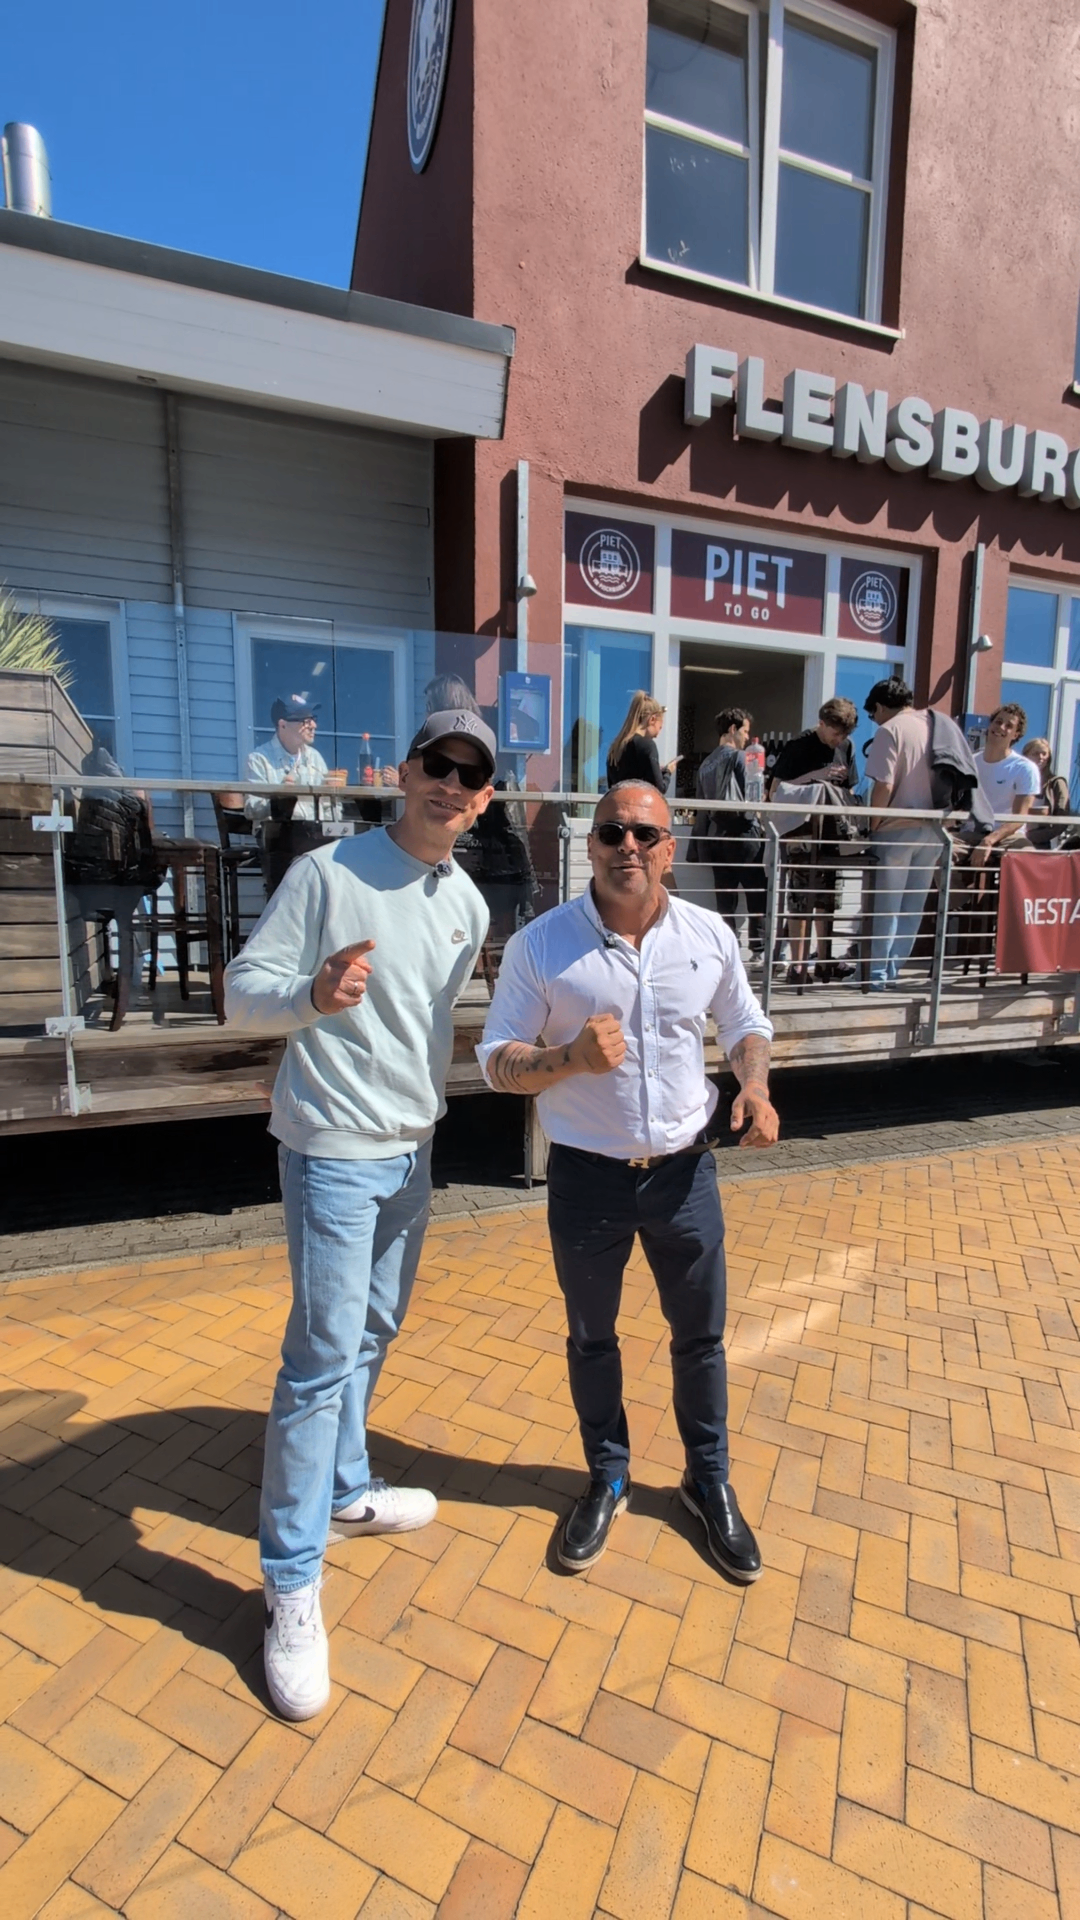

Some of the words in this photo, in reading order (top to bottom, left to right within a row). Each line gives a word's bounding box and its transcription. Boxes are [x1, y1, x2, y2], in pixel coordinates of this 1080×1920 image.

[684, 343, 1080, 511] FLENSBUR
[600, 534, 621, 549] PIET
[705, 544, 793, 609] PIET
[866, 576, 883, 590] PIET
[724, 602, 742, 617] TO
[751, 606, 770, 621] GO
